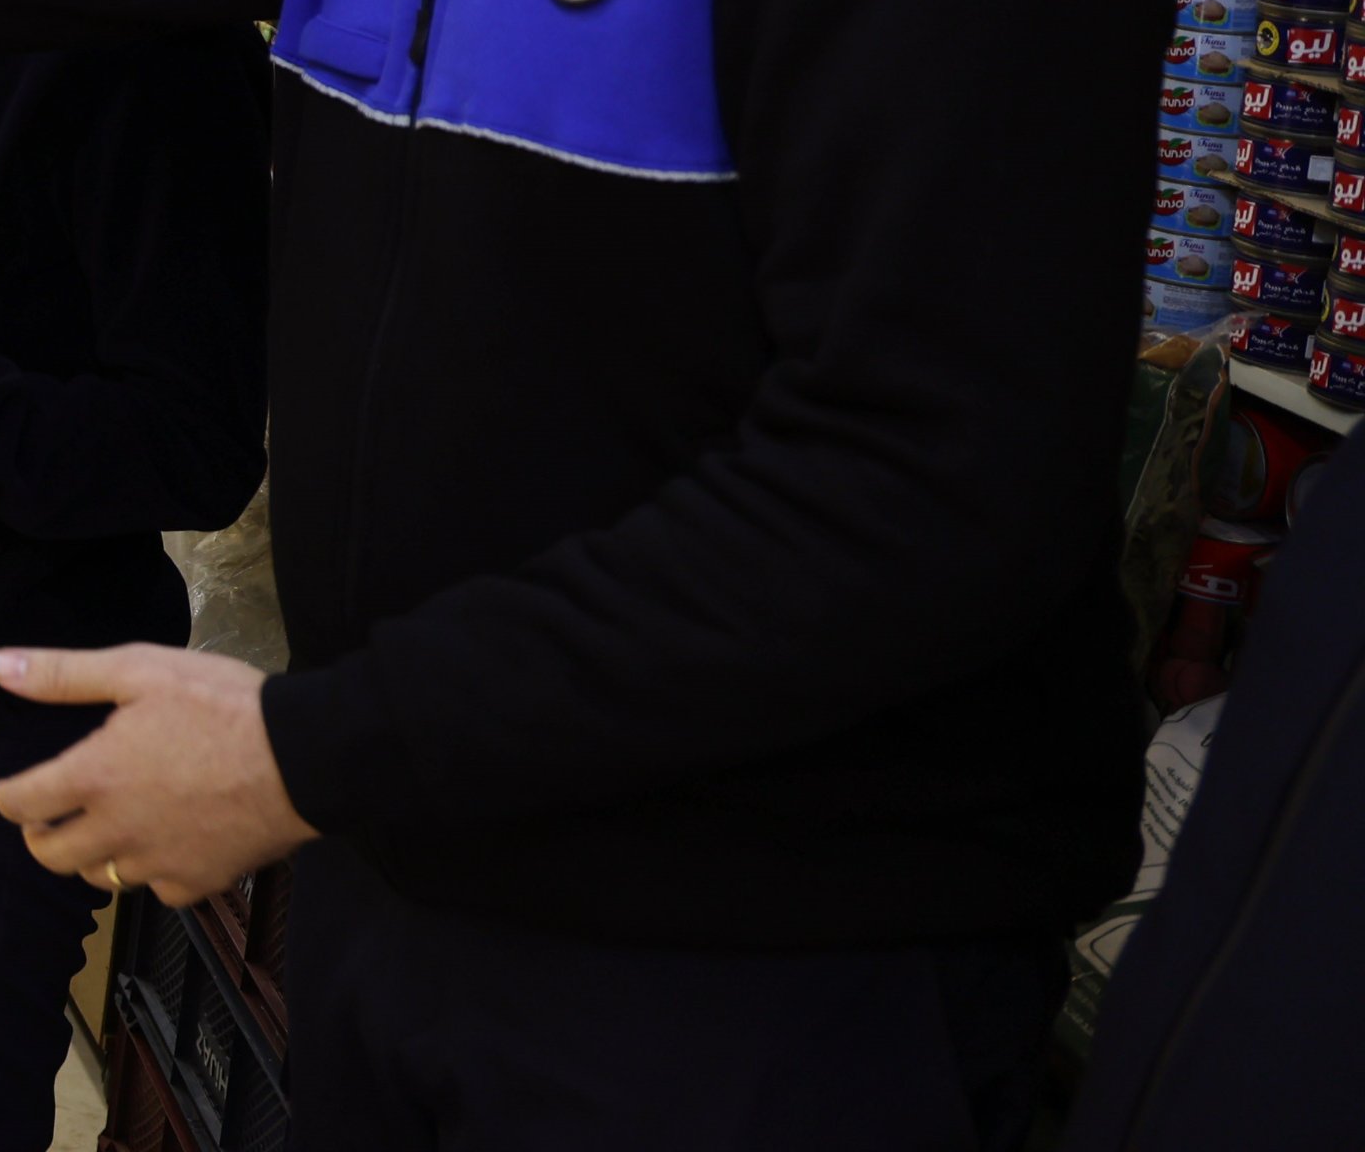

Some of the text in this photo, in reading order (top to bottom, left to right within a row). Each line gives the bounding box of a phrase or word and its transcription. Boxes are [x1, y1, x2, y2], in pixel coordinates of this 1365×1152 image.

[1289, 30, 1334, 60] ليو
[1243, 84, 1271, 113] ليو
[1337, 109, 1361, 142] ليو
[1333, 177, 1364, 205] ليو
[1233, 264, 1259, 292] ليو
